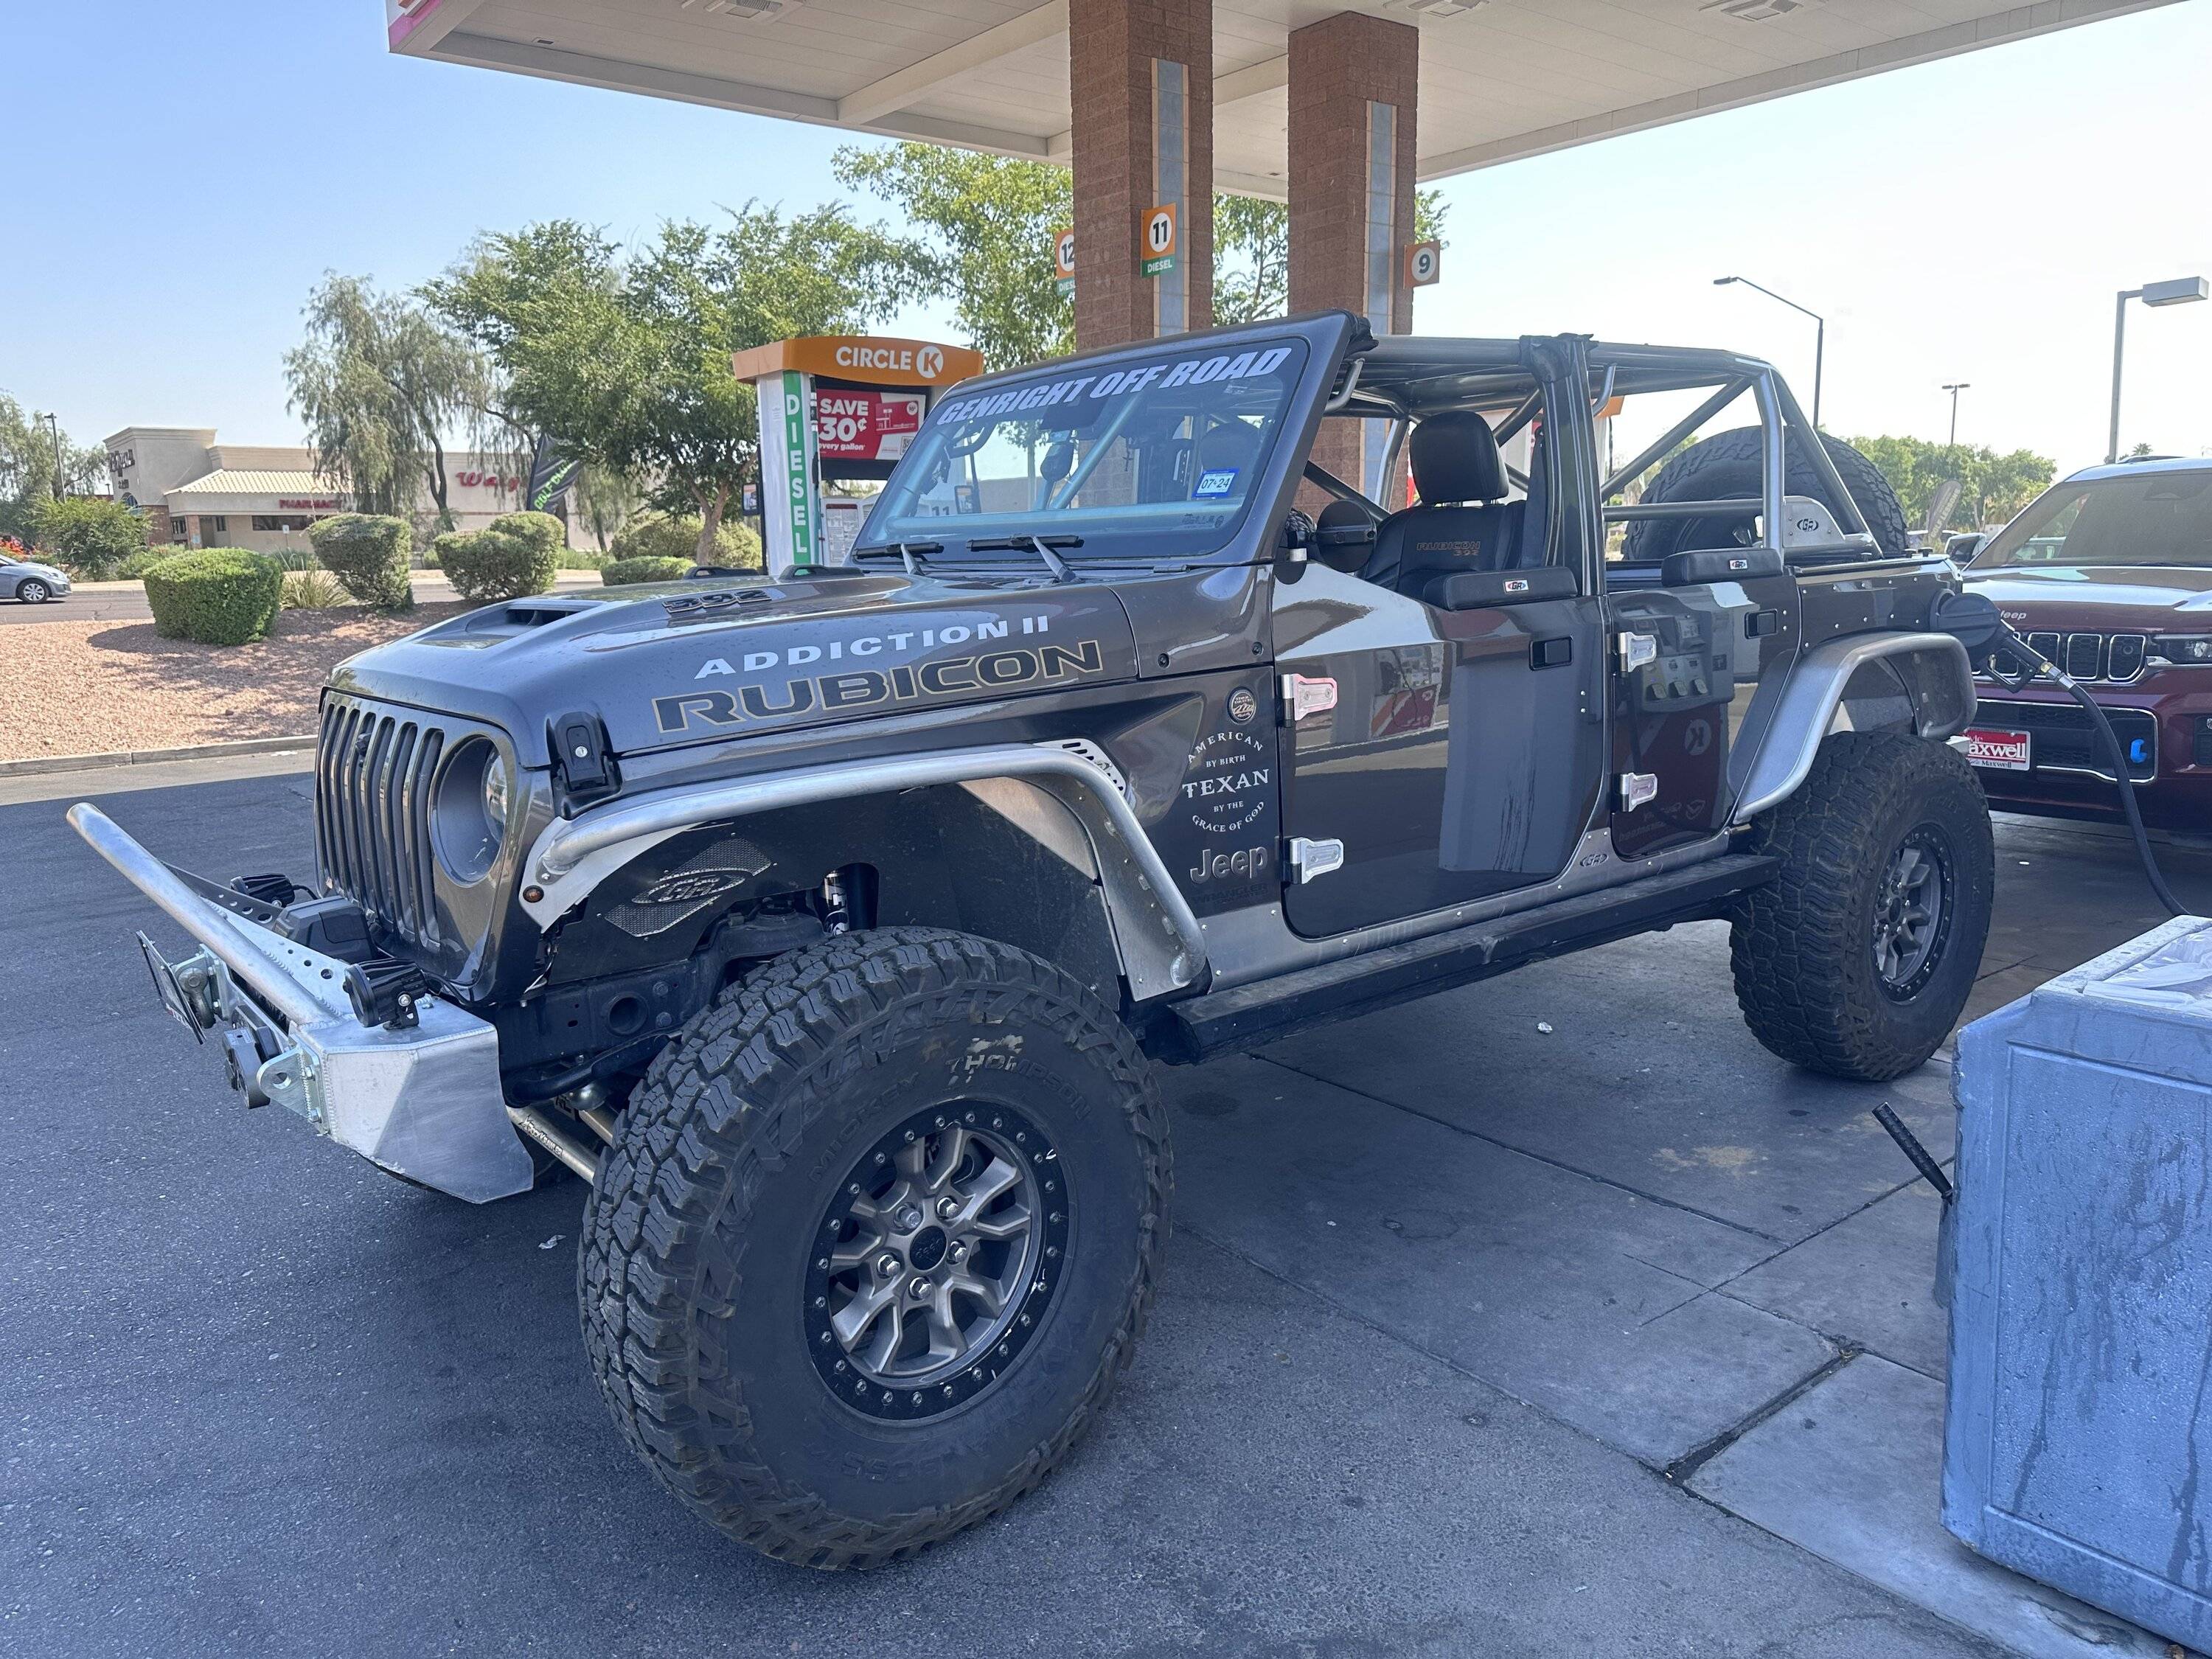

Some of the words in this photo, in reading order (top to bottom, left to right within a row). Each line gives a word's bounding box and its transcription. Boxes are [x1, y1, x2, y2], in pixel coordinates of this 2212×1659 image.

[1153, 220, 1167, 244] 11
[1147, 259, 1172, 273] DIESEL
[1419, 254, 1430, 274] 9
[836, 346, 911, 371] CIRCLE
[921, 350, 942, 377] K
[936, 377, 1096, 425] GENRIGHT
[1090, 364, 1168, 399] OFF
[1164, 347, 1293, 388] ROAD
[820, 398, 869, 416] SAVE
[818, 417, 868, 442] 30¢
[786, 394, 808, 554] DIESEL
[1416, 541, 1481, 551] RUBICON
[661, 589, 773, 613] 392
[694, 619, 1008, 680] ADDICTION
[1022, 616, 1048, 635] II
[651, 639, 1104, 734] RUBICON
[1187, 731, 1263, 763] AMERICAN
[1206, 759, 1217, 768] BY
[1220, 754, 1246, 765] BIRTH
[1969, 742, 2026, 759] axwell
[1181, 768, 1270, 799] TEXAN
[1192, 815, 1226, 832] GRACE
[1229, 820, 1242, 832] OF
[1245, 801, 1265, 824] GOD
[1214, 804, 1225, 813] BY
[1227, 800, 1245, 810] THE
[1190, 846, 1268, 885] Jeep
[946, 1053, 1092, 1121] THOMPSON
